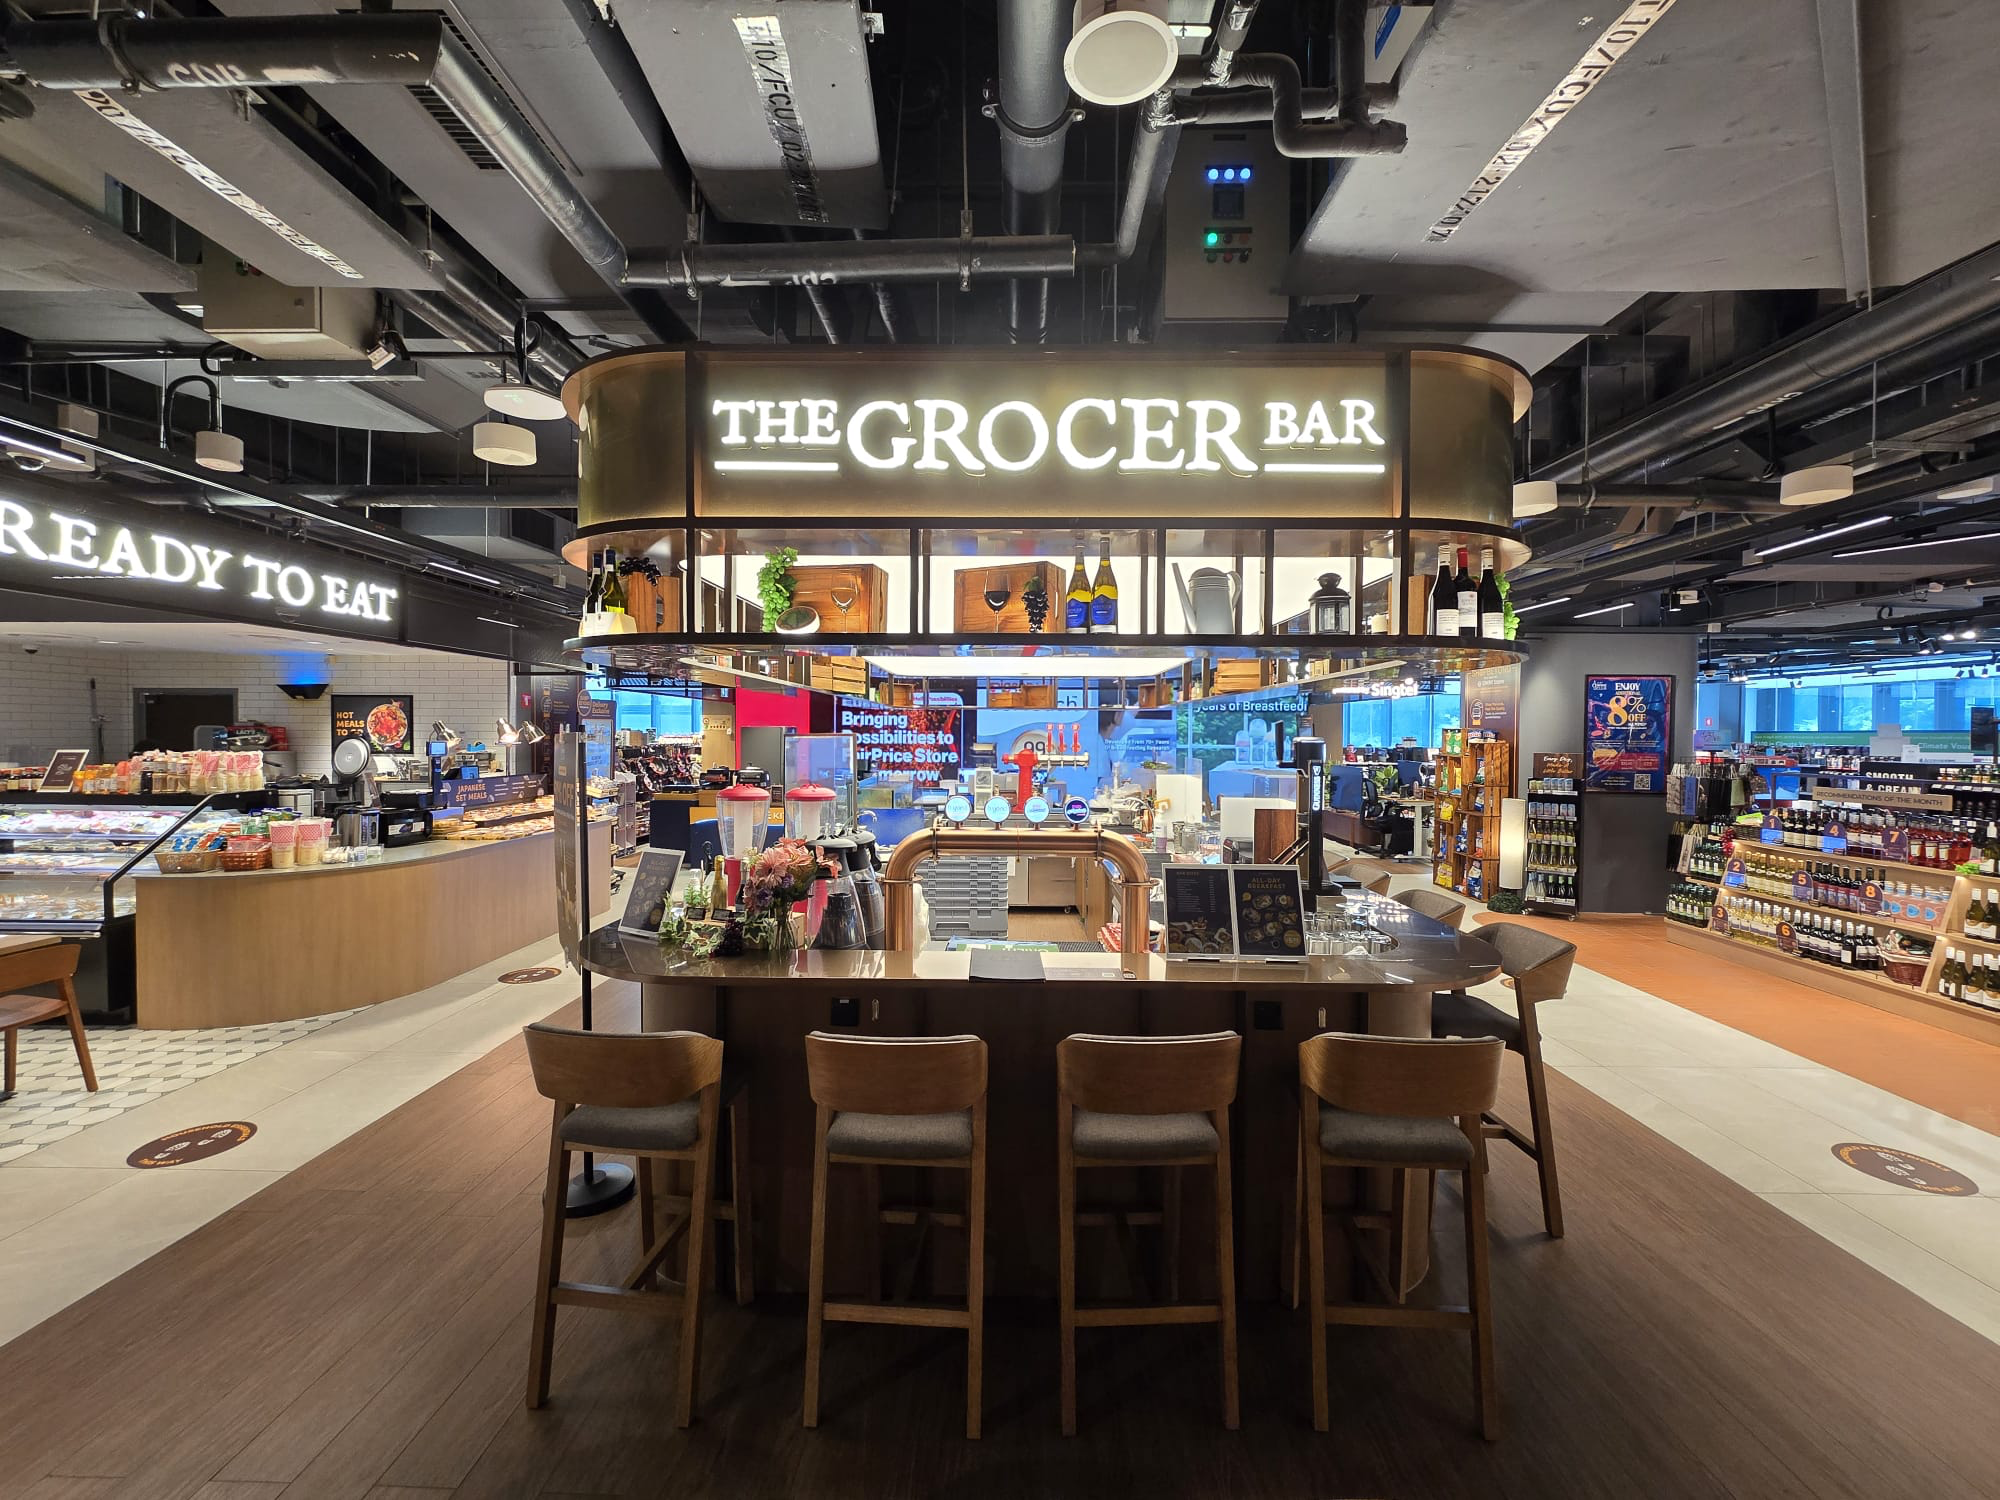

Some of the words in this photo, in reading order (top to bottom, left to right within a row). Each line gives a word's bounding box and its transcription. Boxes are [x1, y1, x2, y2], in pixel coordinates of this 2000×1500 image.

[712, 399, 840, 445] THE
[845, 397, 1259, 472] GROCER
[1263, 400, 1386, 446] BAR
[0, 498, 233, 591] READY
[243, 554, 315, 607] TO
[321, 574, 399, 622] EAT
[1371, 681, 1418, 700] Singtel
[1615, 682, 1641, 691] ENJOY
[336, 711, 354, 719] HOT
[1607, 695, 1647, 726] 8%
[841, 710, 908, 729] Bringing
[1628, 713, 1647, 722] OFF
[336, 720, 365, 728] MEALS
[336, 729, 348, 737] TO
[939, 731, 954, 745] to
[1918, 742, 1949, 750] Climate
[914, 747, 959, 763] Store
[457, 783, 487, 793] JAPANESE
[455, 793, 470, 802] SET
[470, 791, 488, 801] MEALS
[1816, 790, 1883, 802] RECOMMENDATIONS
[1896, 796, 1913, 804] THE
[1913, 797, 1943, 806] MONTH
[1769, 818, 1776, 828] 1
[1829, 826, 1839, 837] 4
[1889, 831, 1900, 843] 7
[1733, 861, 1741, 871] 2
[1797, 873, 1806, 885] 5
[1865, 884, 1876, 897] 8
[1716, 907, 1724, 918] 3
[1781, 925, 1790, 937] 6
